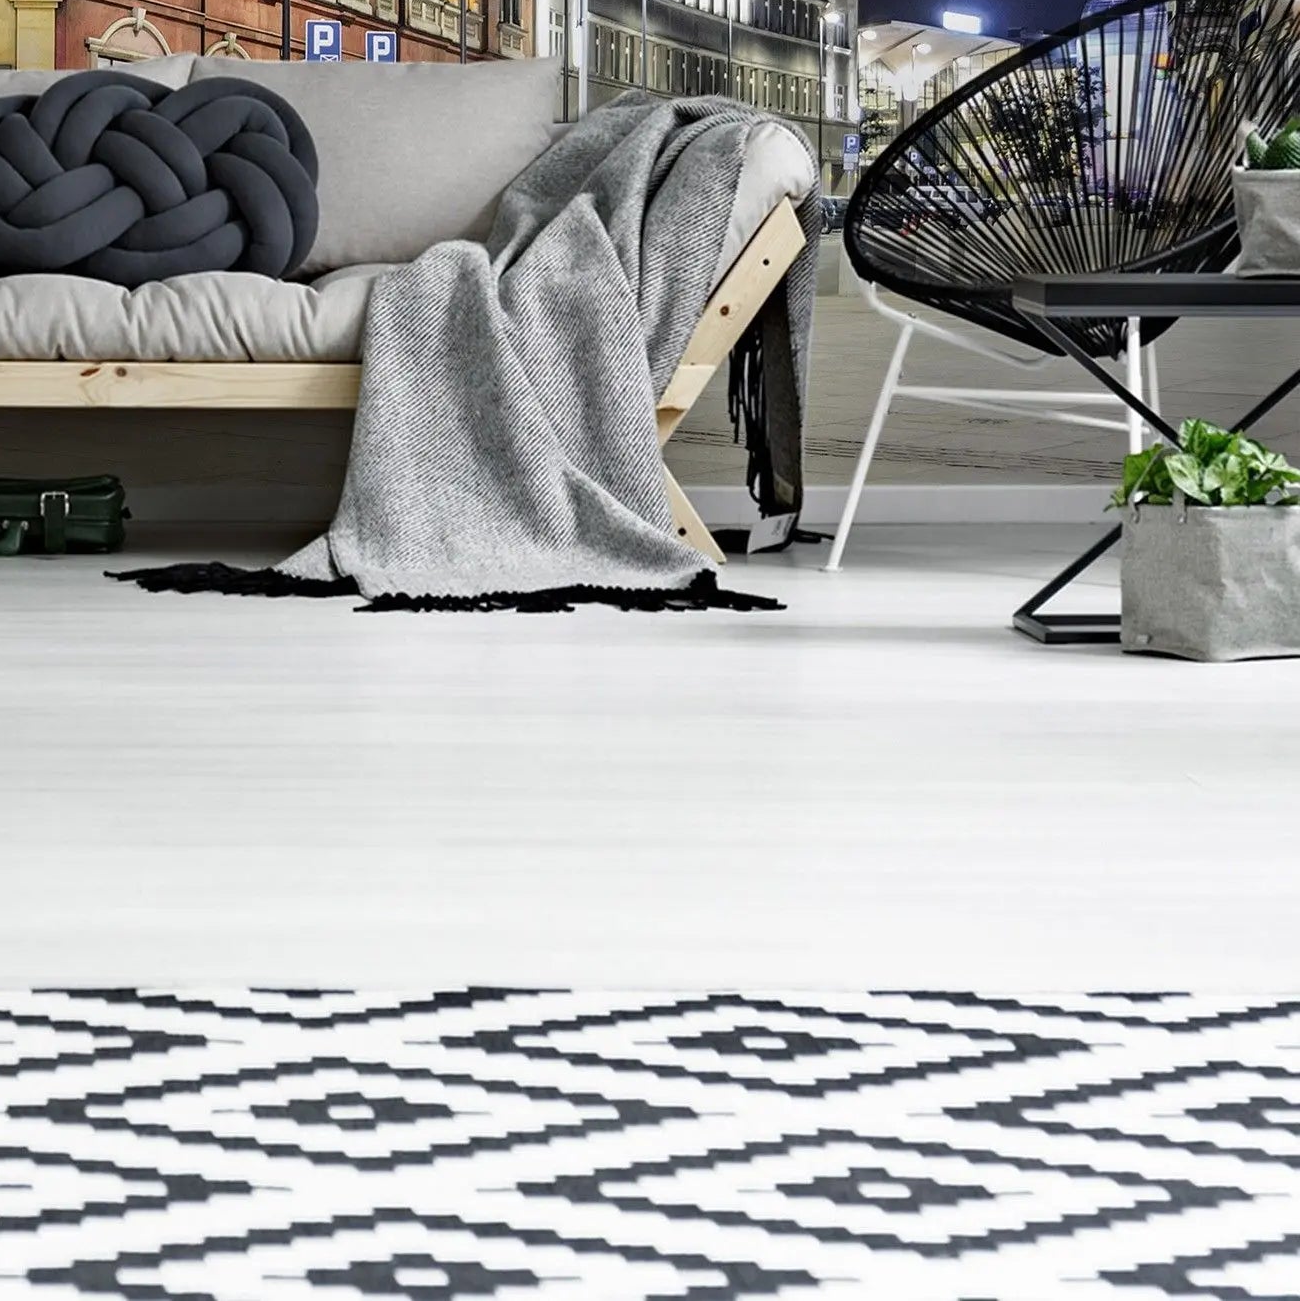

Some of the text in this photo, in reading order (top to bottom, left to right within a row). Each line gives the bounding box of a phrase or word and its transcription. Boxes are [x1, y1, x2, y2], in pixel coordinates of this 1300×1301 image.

[313, 25, 334, 54] P
[373, 35, 390, 62] P
[847, 136, 856, 149] P
[910, 152, 918, 162] P
